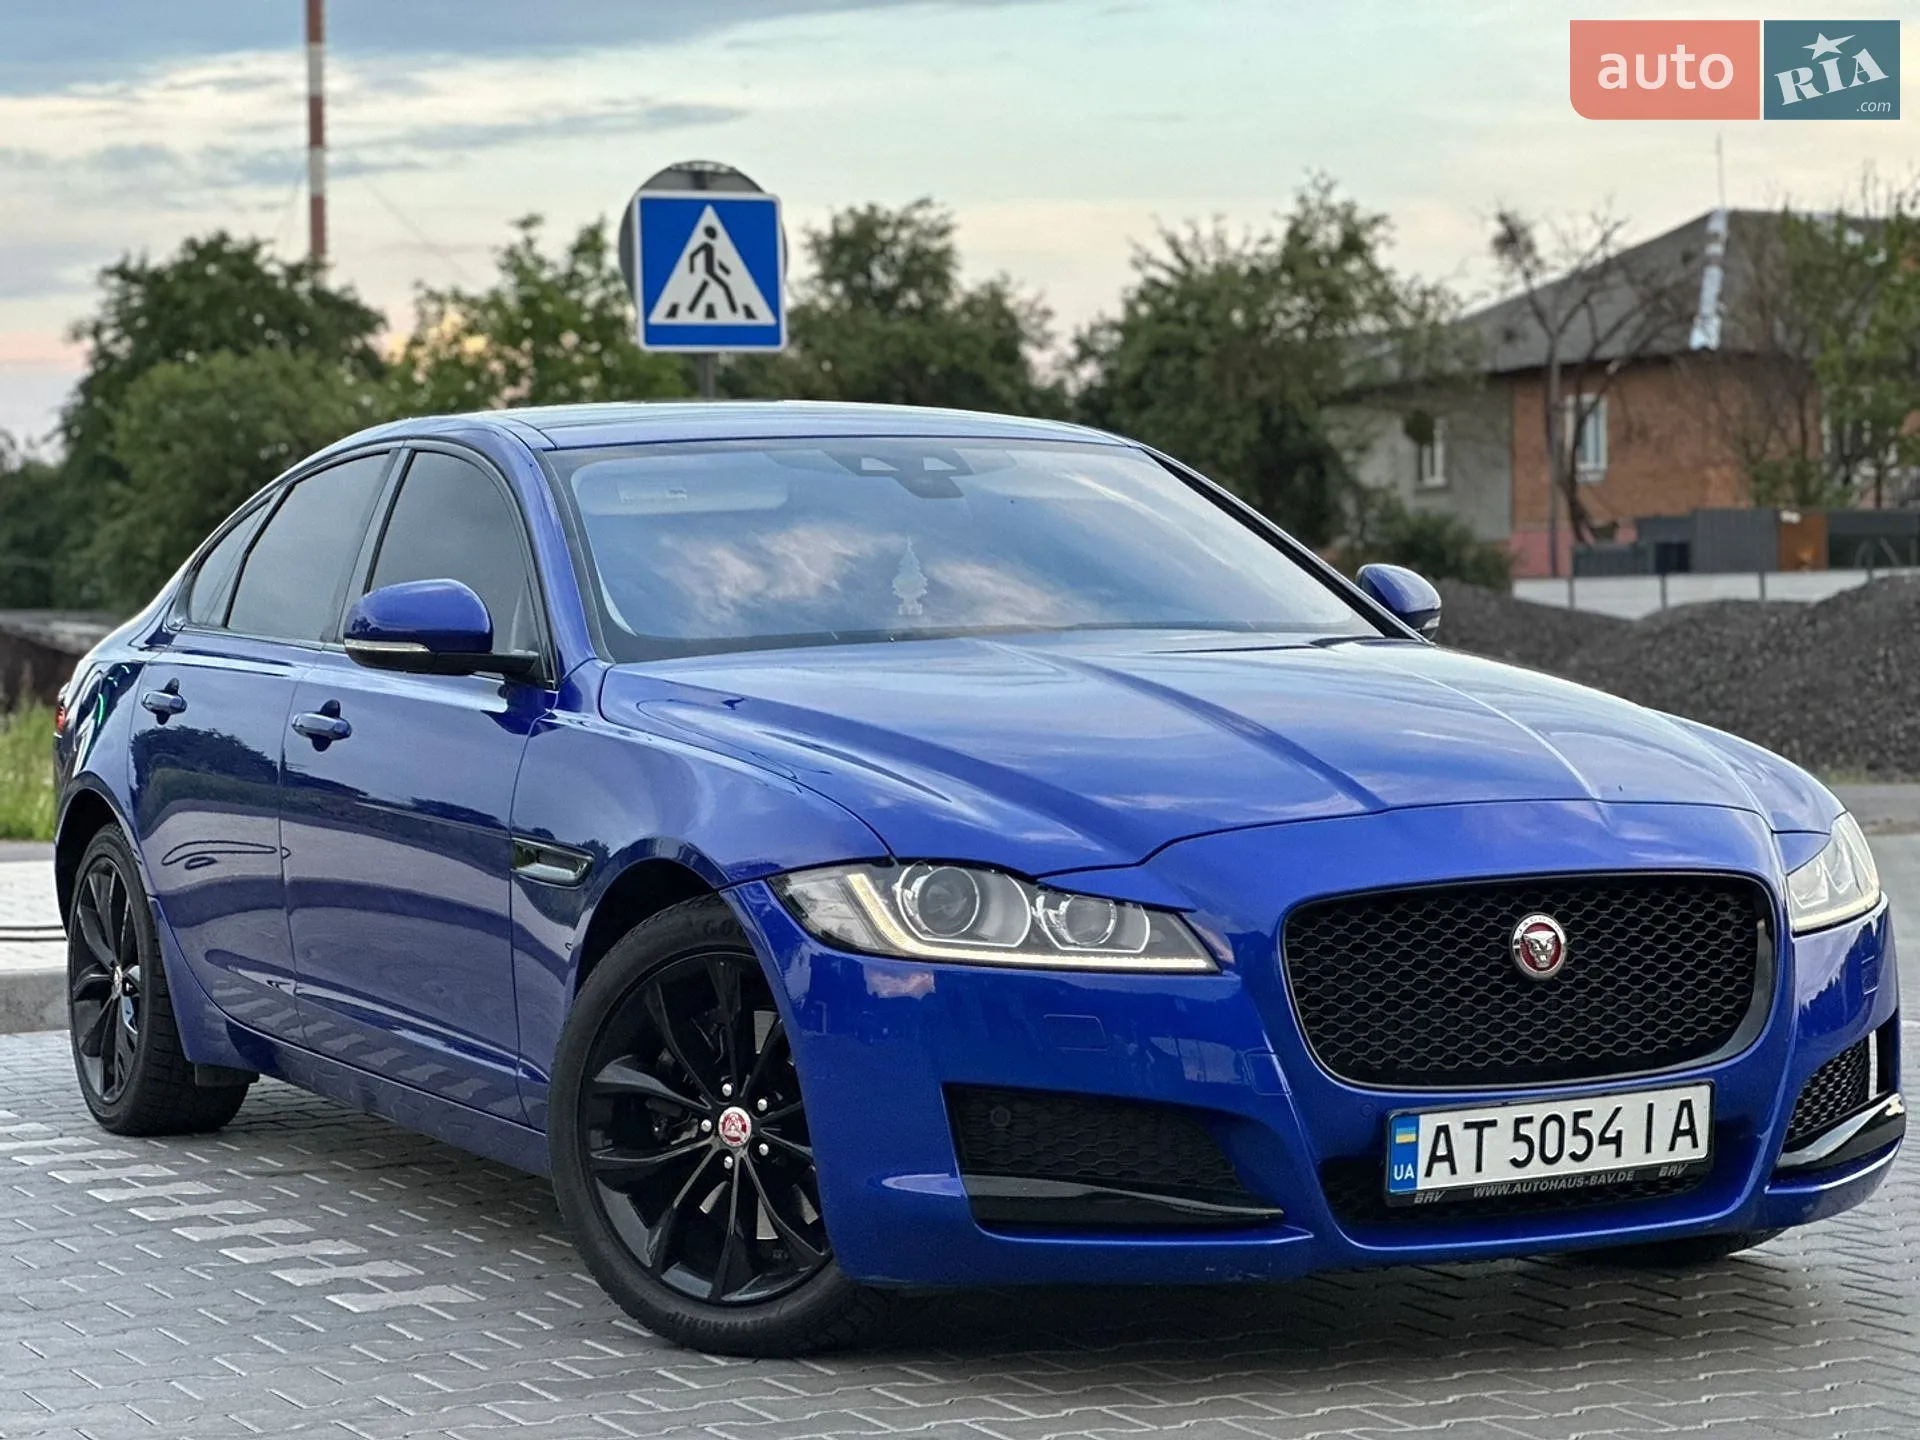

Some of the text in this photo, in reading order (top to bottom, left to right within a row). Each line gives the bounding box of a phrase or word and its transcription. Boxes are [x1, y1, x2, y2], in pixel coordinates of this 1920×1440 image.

[1424, 1098, 1700, 1179] AT 5054 IA
[1393, 1165, 1415, 1181] UA
[1473, 1170, 1636, 1199] WWW.AUTOHAUS-BAV.DE
